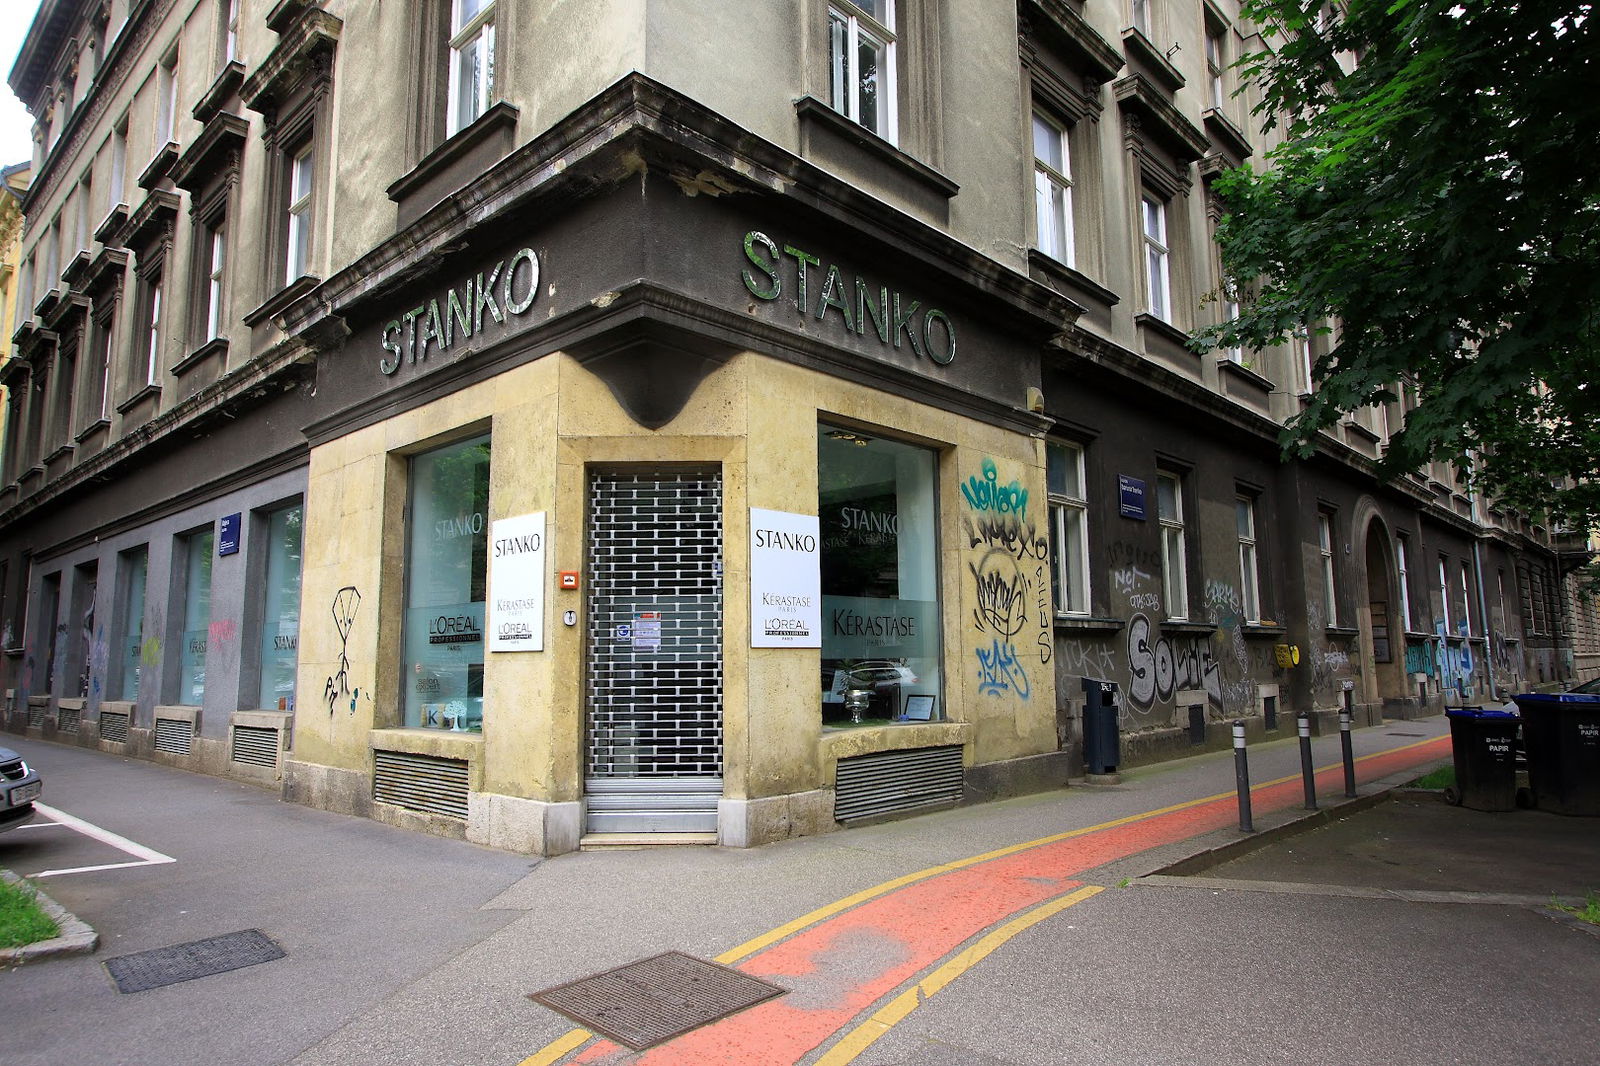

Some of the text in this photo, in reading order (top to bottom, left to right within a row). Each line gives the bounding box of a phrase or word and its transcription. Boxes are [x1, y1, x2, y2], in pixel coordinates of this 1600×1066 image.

[741, 230, 956, 366] STANKO
[380, 247, 540, 375] STANKO
[434, 512, 483, 541] STANKO
[495, 533, 541, 558] STANKO
[756, 529, 816, 553] STANKO
[762, 592, 811, 607] KÉRASTASE
[429, 613, 481, 634] L'ORÉAL
[764, 617, 810, 630] L'ORÉAL
[833, 608, 916, 637] KÉRASTASE
[428, 710, 438, 725] K
